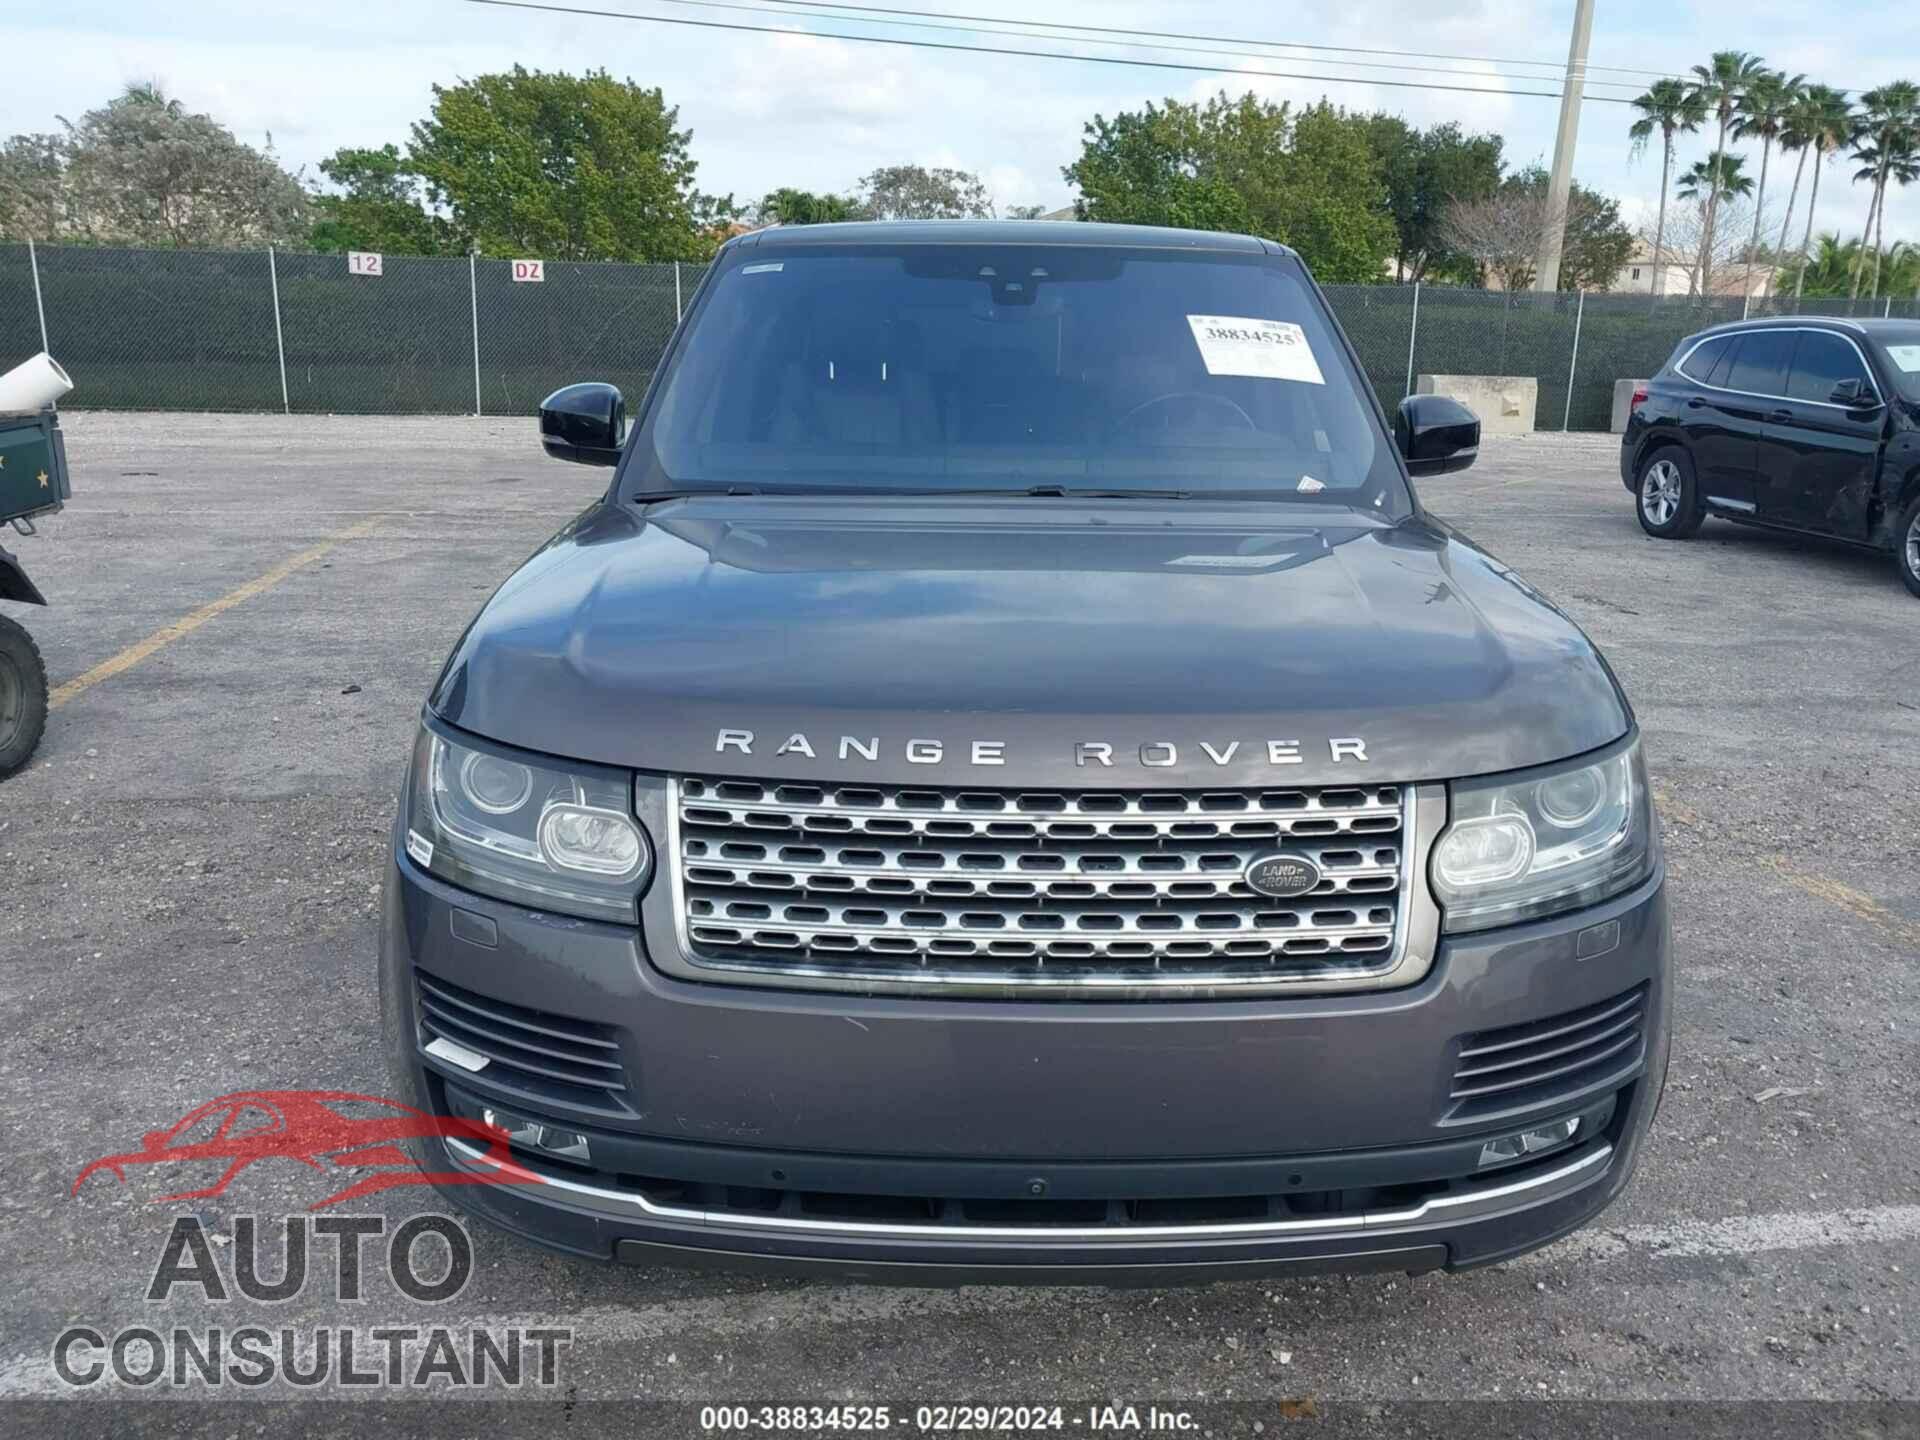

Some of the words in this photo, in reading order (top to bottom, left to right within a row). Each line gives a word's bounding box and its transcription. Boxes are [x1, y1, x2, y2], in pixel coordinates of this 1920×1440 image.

[353, 255, 377, 271] 12
[515, 262, 540, 278] DZ
[1204, 327, 1296, 346] 38834525
[715, 728, 1006, 765] RANGE
[1074, 736, 1369, 767] ROVER
[1262, 864, 1297, 876] LAND
[1265, 876, 1307, 888] ROVER
